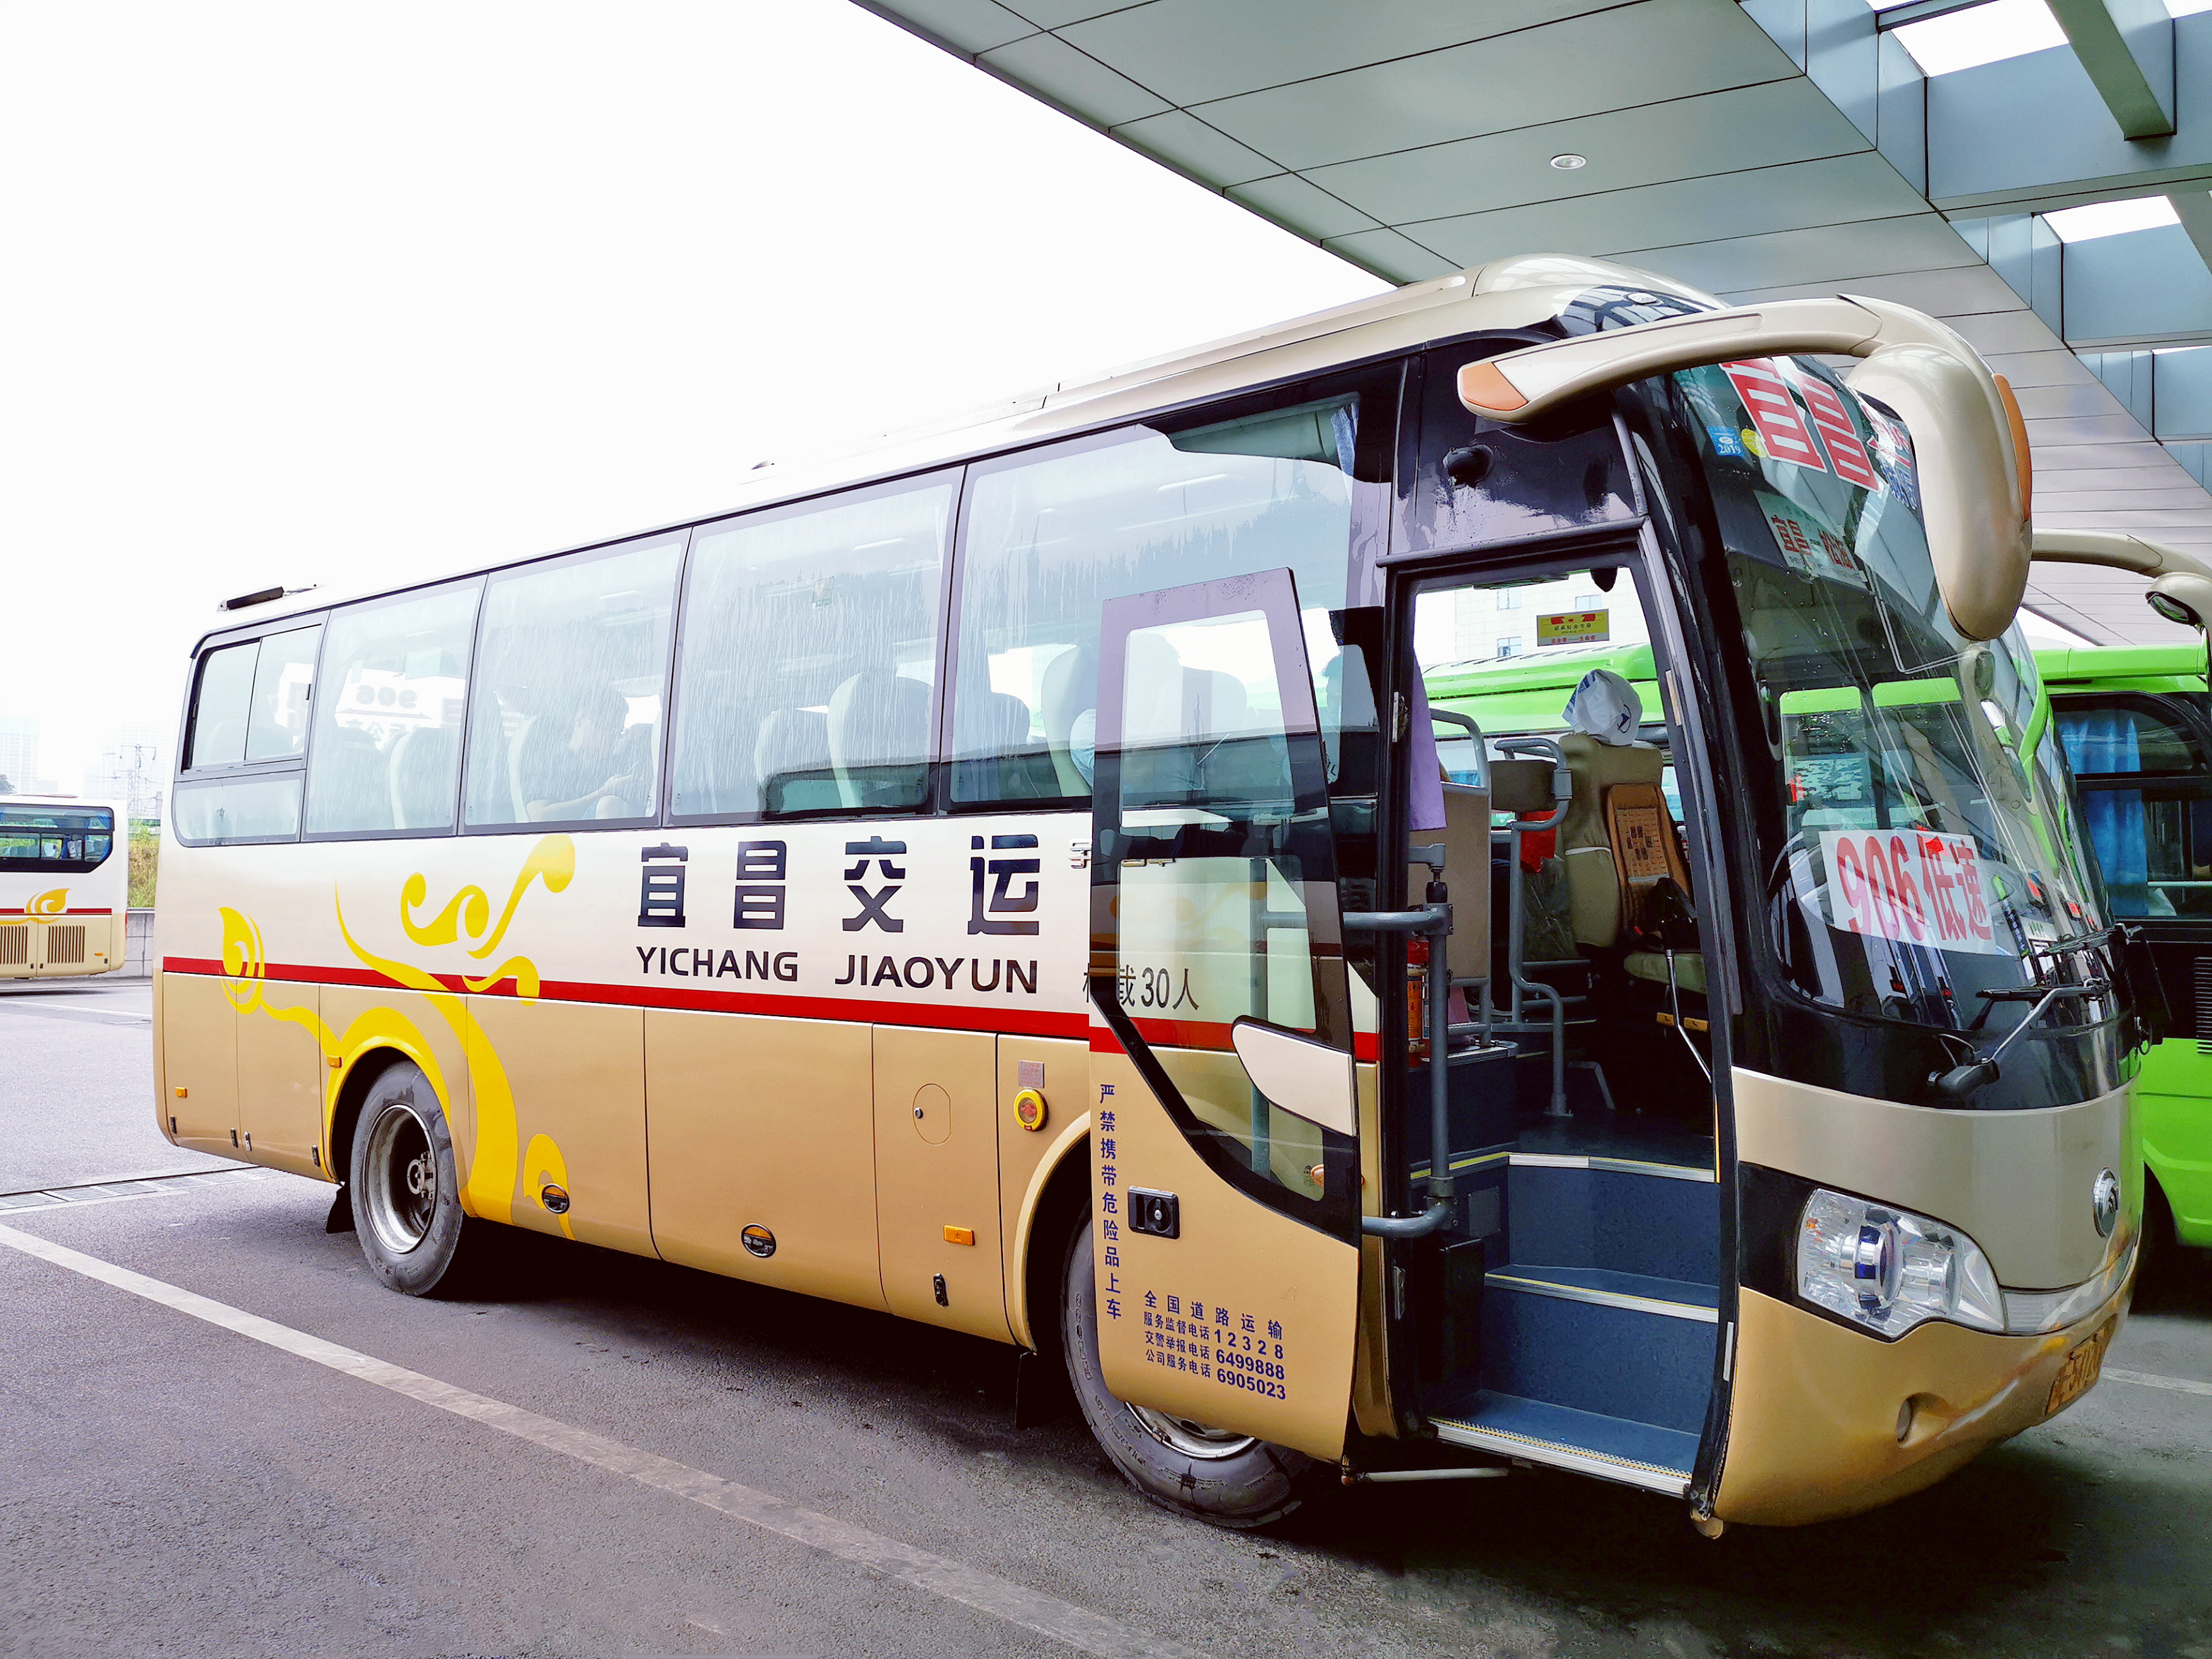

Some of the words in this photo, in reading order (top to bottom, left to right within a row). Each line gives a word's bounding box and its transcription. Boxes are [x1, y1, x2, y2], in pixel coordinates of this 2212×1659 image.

[1717, 443, 1742, 454] 2019
[1771, 514, 1813, 557] 宜昌
[638, 835, 1040, 935] 宜昌交运
[636, 947, 798, 981] YICHANG
[835, 954, 1038, 994] JIAOYUN
[1099, 1083, 1122, 1320] 严禁携带危险品上车
[1143, 1311, 1210, 1341] 服务监督电话
[1214, 1328, 1284, 1360] 12328
[1144, 1289, 1284, 1340] 全国道路运输
[1145, 1329, 1211, 1361] 交警举报电话
[1216, 1349, 1285, 1380] 6499888
[1145, 1348, 1212, 1378] 公司服务电话
[1217, 1368, 1287, 1401] 6905023
